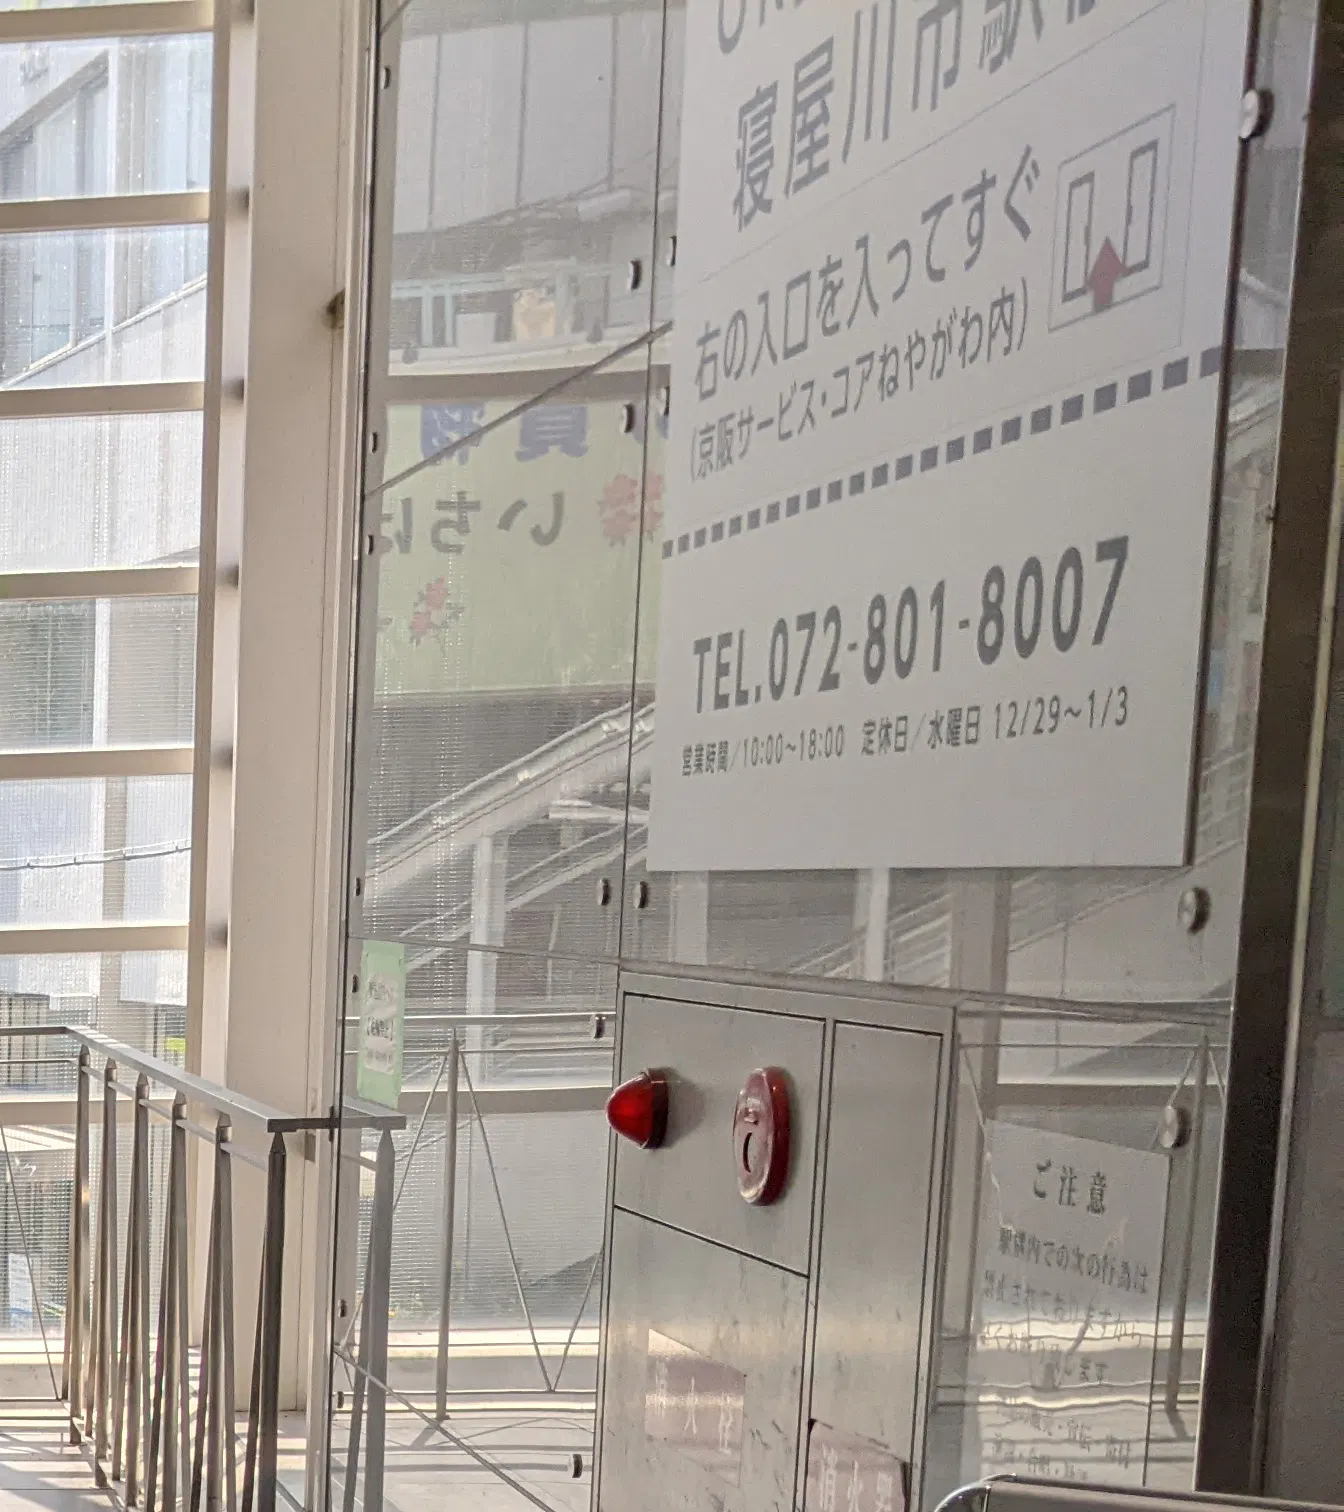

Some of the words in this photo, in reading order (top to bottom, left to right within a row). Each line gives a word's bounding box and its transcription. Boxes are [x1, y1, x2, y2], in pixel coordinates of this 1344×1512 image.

[696, 145, 1040, 401] 右の入口を入ってすぐ
[693, 535, 1129, 713] TEL.072-801-8007
[1033, 1156, 1108, 1216] ご注意
